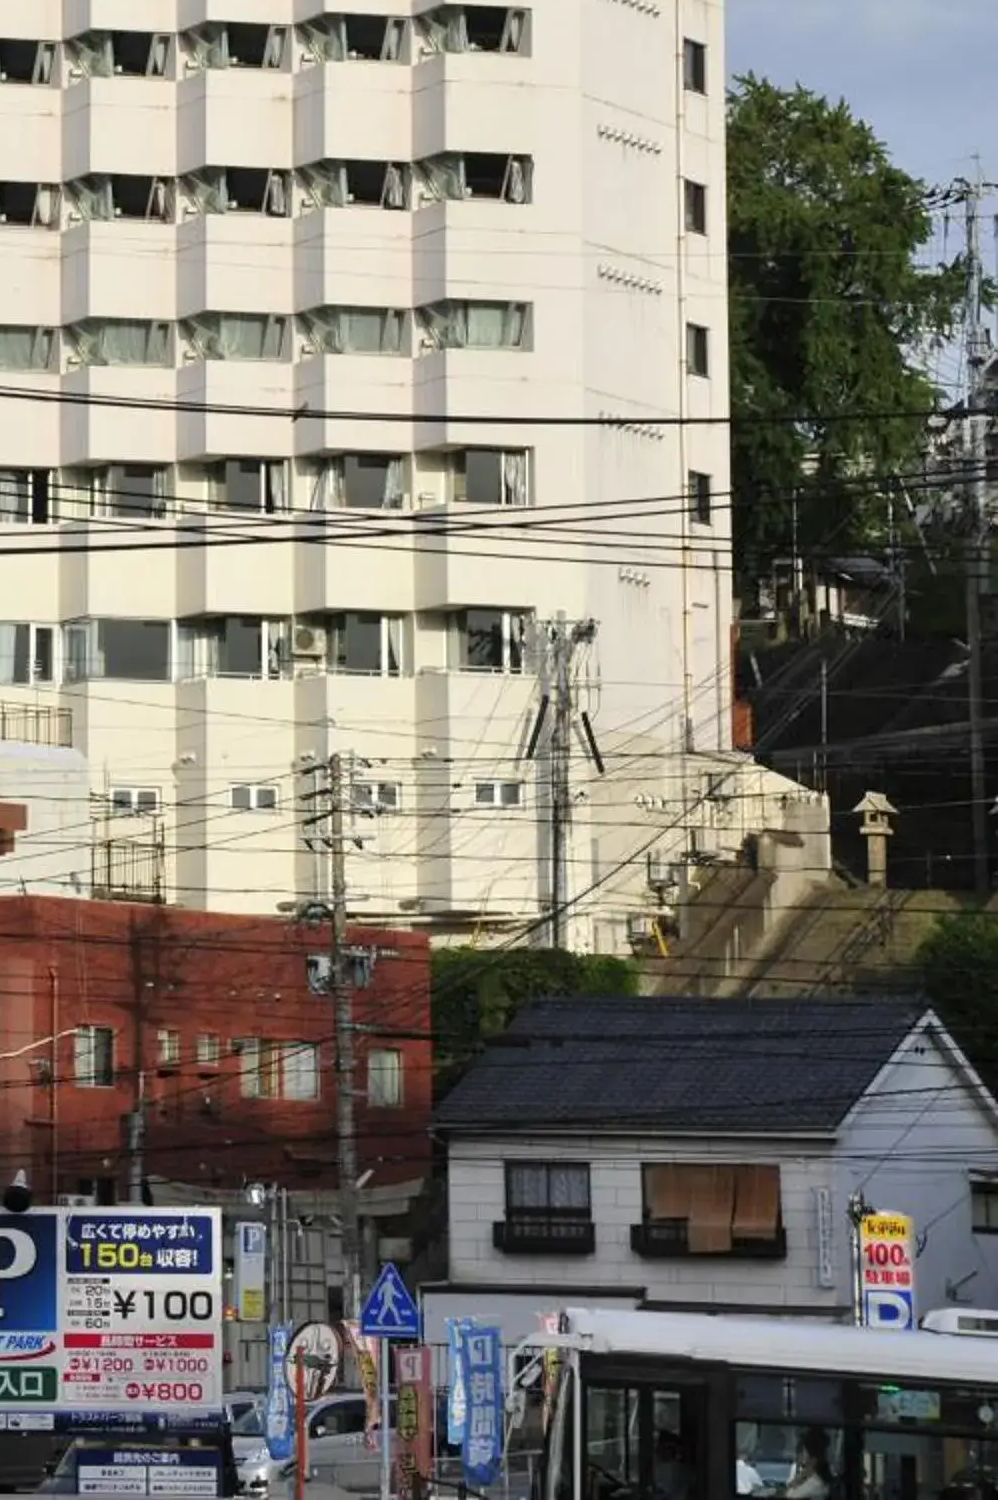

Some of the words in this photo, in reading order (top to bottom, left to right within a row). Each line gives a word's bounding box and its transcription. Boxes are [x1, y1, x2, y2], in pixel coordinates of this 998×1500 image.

[80, 1243, 153, 1267] 150台
[113, 1290, 213, 1320] ¥100
[6, 1335, 45, 1349] PARK
[142, 1383, 204, 1400] ¥800
